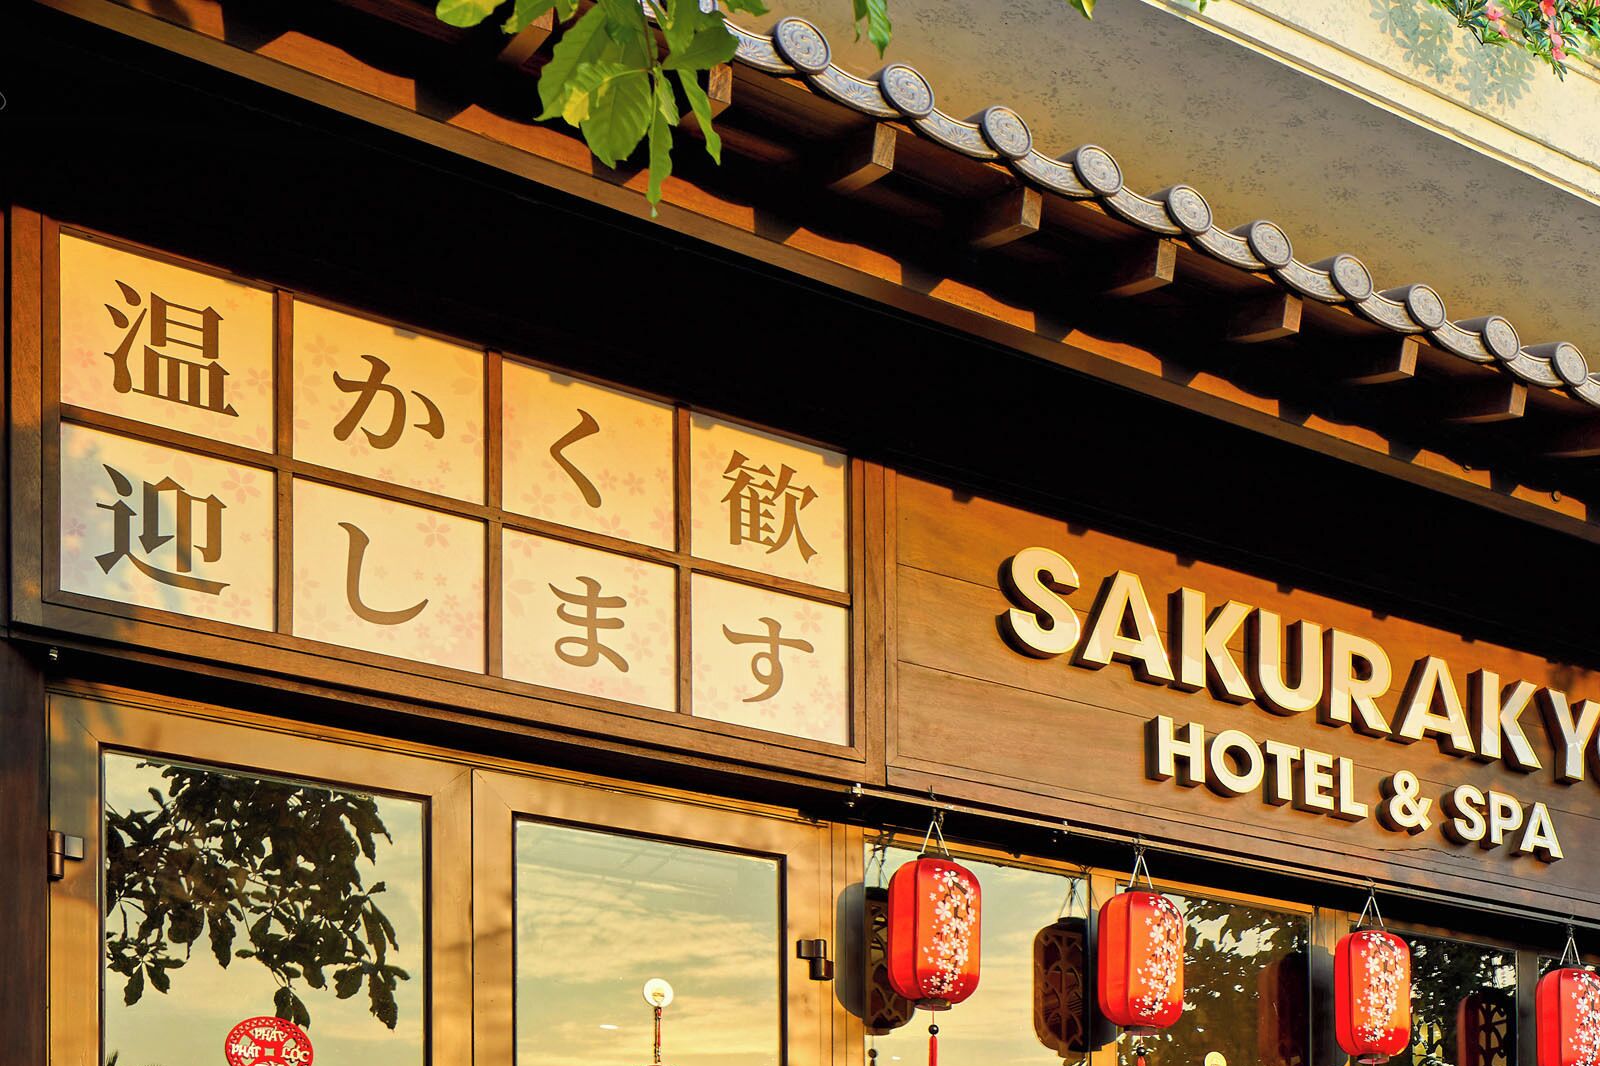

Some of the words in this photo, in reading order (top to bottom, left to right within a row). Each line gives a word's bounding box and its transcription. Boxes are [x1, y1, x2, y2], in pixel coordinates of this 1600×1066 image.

[1151, 715, 1368, 821] HOTEL
[1381, 770, 1432, 832] &
[1446, 783, 1564, 861] SPA
